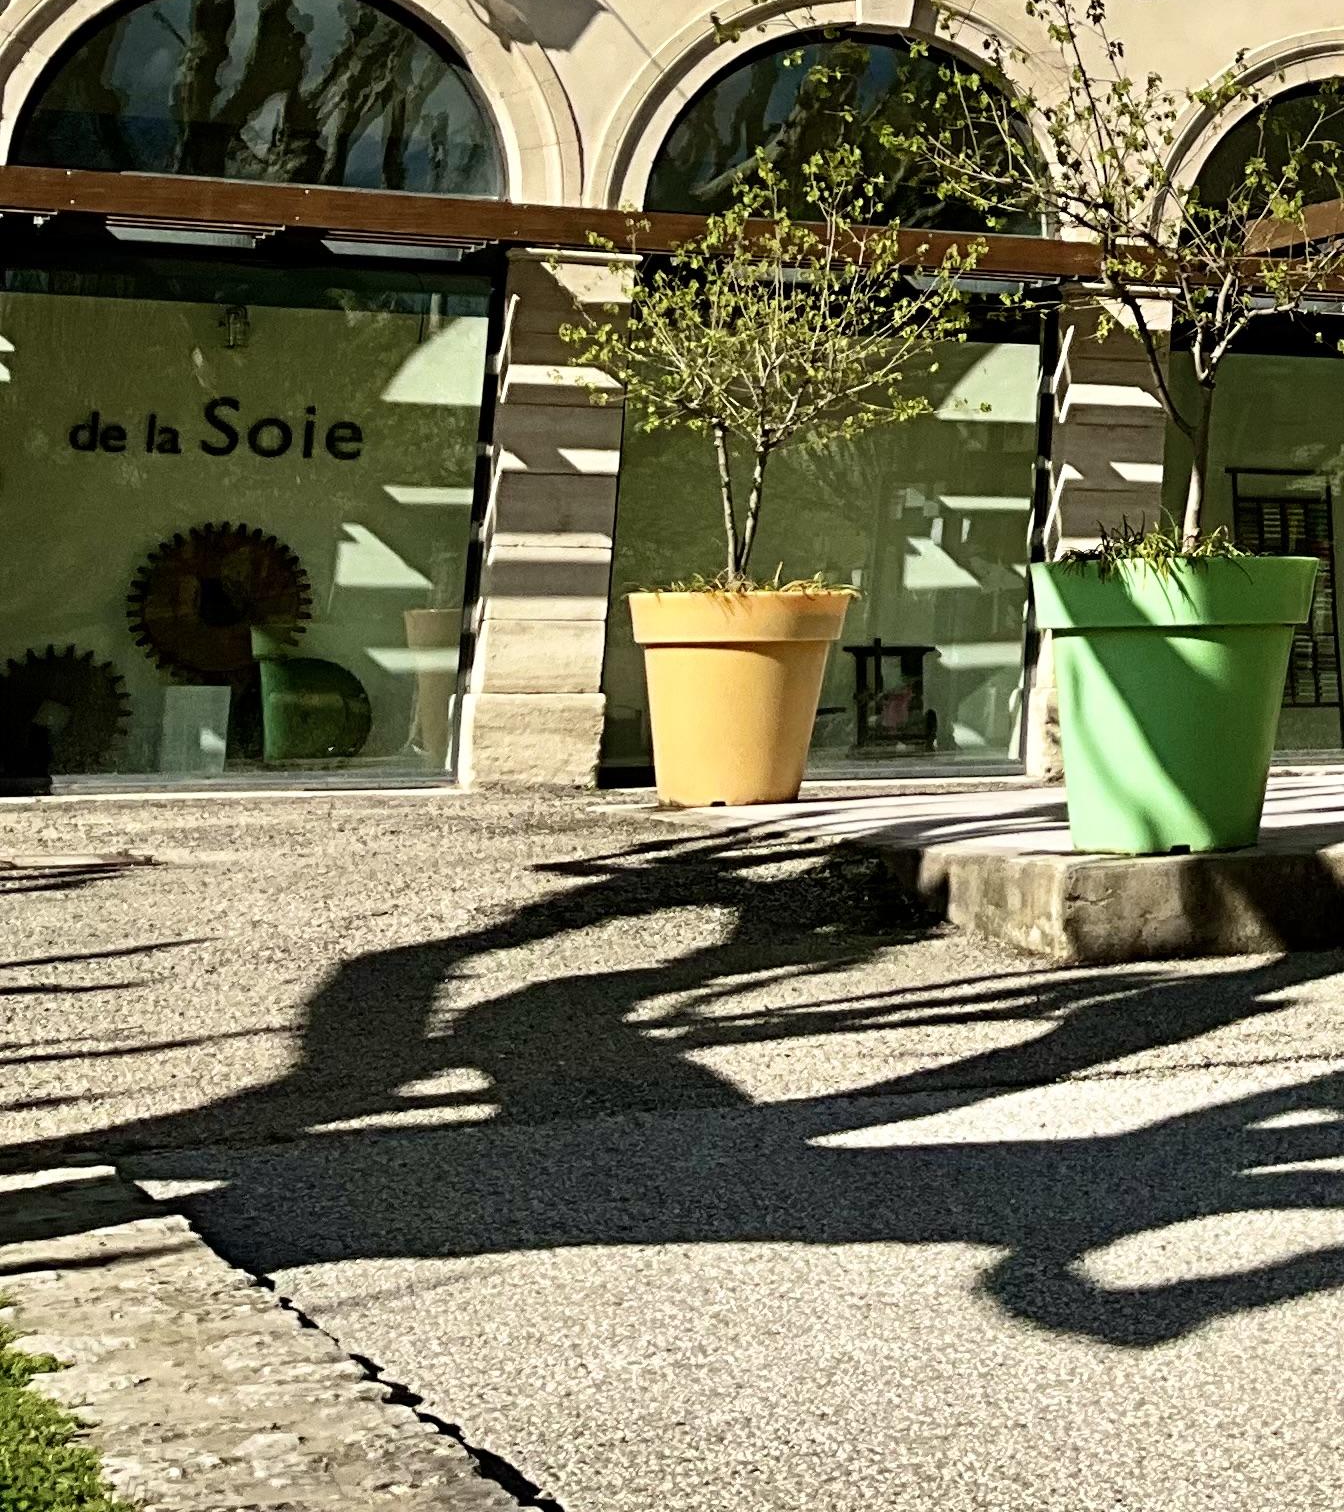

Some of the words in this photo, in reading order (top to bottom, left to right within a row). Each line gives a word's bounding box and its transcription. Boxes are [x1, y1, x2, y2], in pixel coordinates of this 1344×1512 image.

[68, 411, 128, 453] de
[146, 413, 182, 454] la
[201, 396, 364, 461] Soie
